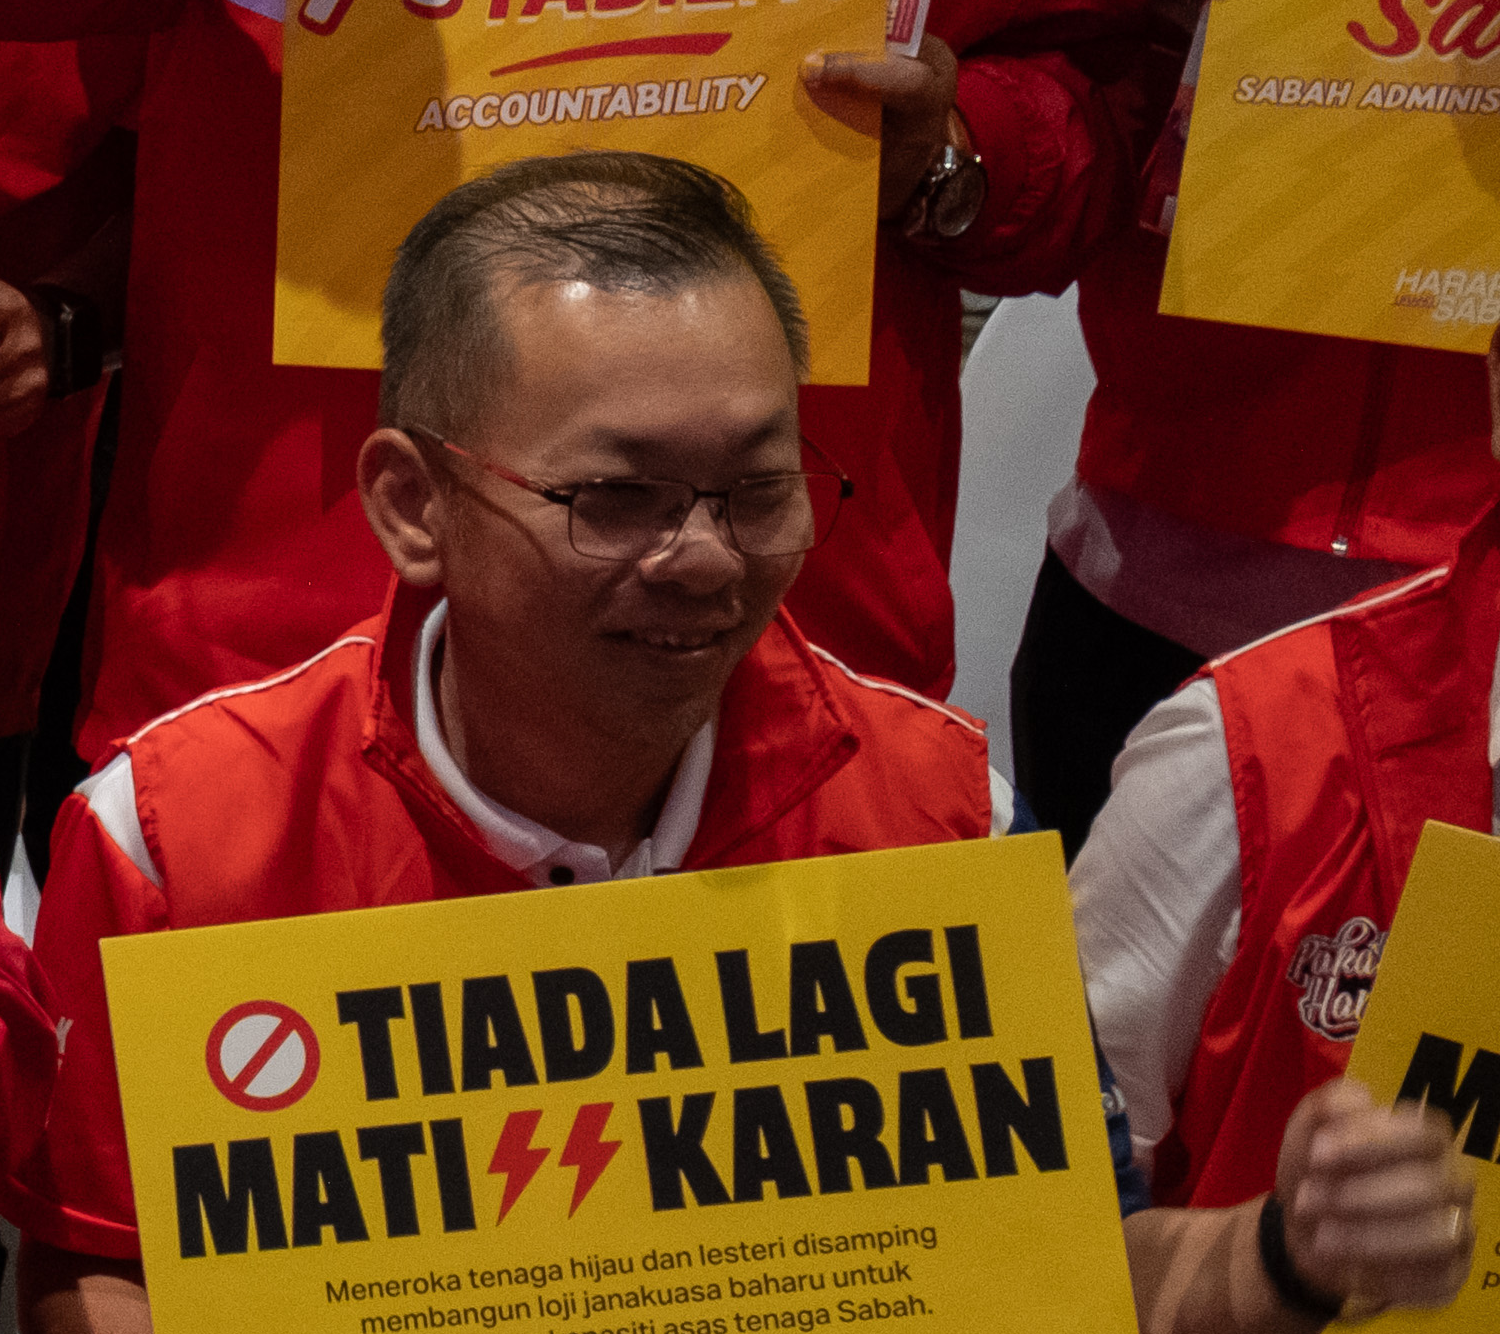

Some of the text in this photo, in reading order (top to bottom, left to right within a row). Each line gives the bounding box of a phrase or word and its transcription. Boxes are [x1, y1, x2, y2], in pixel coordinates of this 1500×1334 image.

[413, 74, 767, 133] ACCOUNTABILITY
[1236, 74, 1500, 114] SABAH ADMINIS
[336, 924, 993, 1103] TIADA LAGI
[171, 1057, 1071, 1260] MATI KARAN
[324, 1225, 938, 1303] Meneroka tenaga hijau dan lesteri disamping
